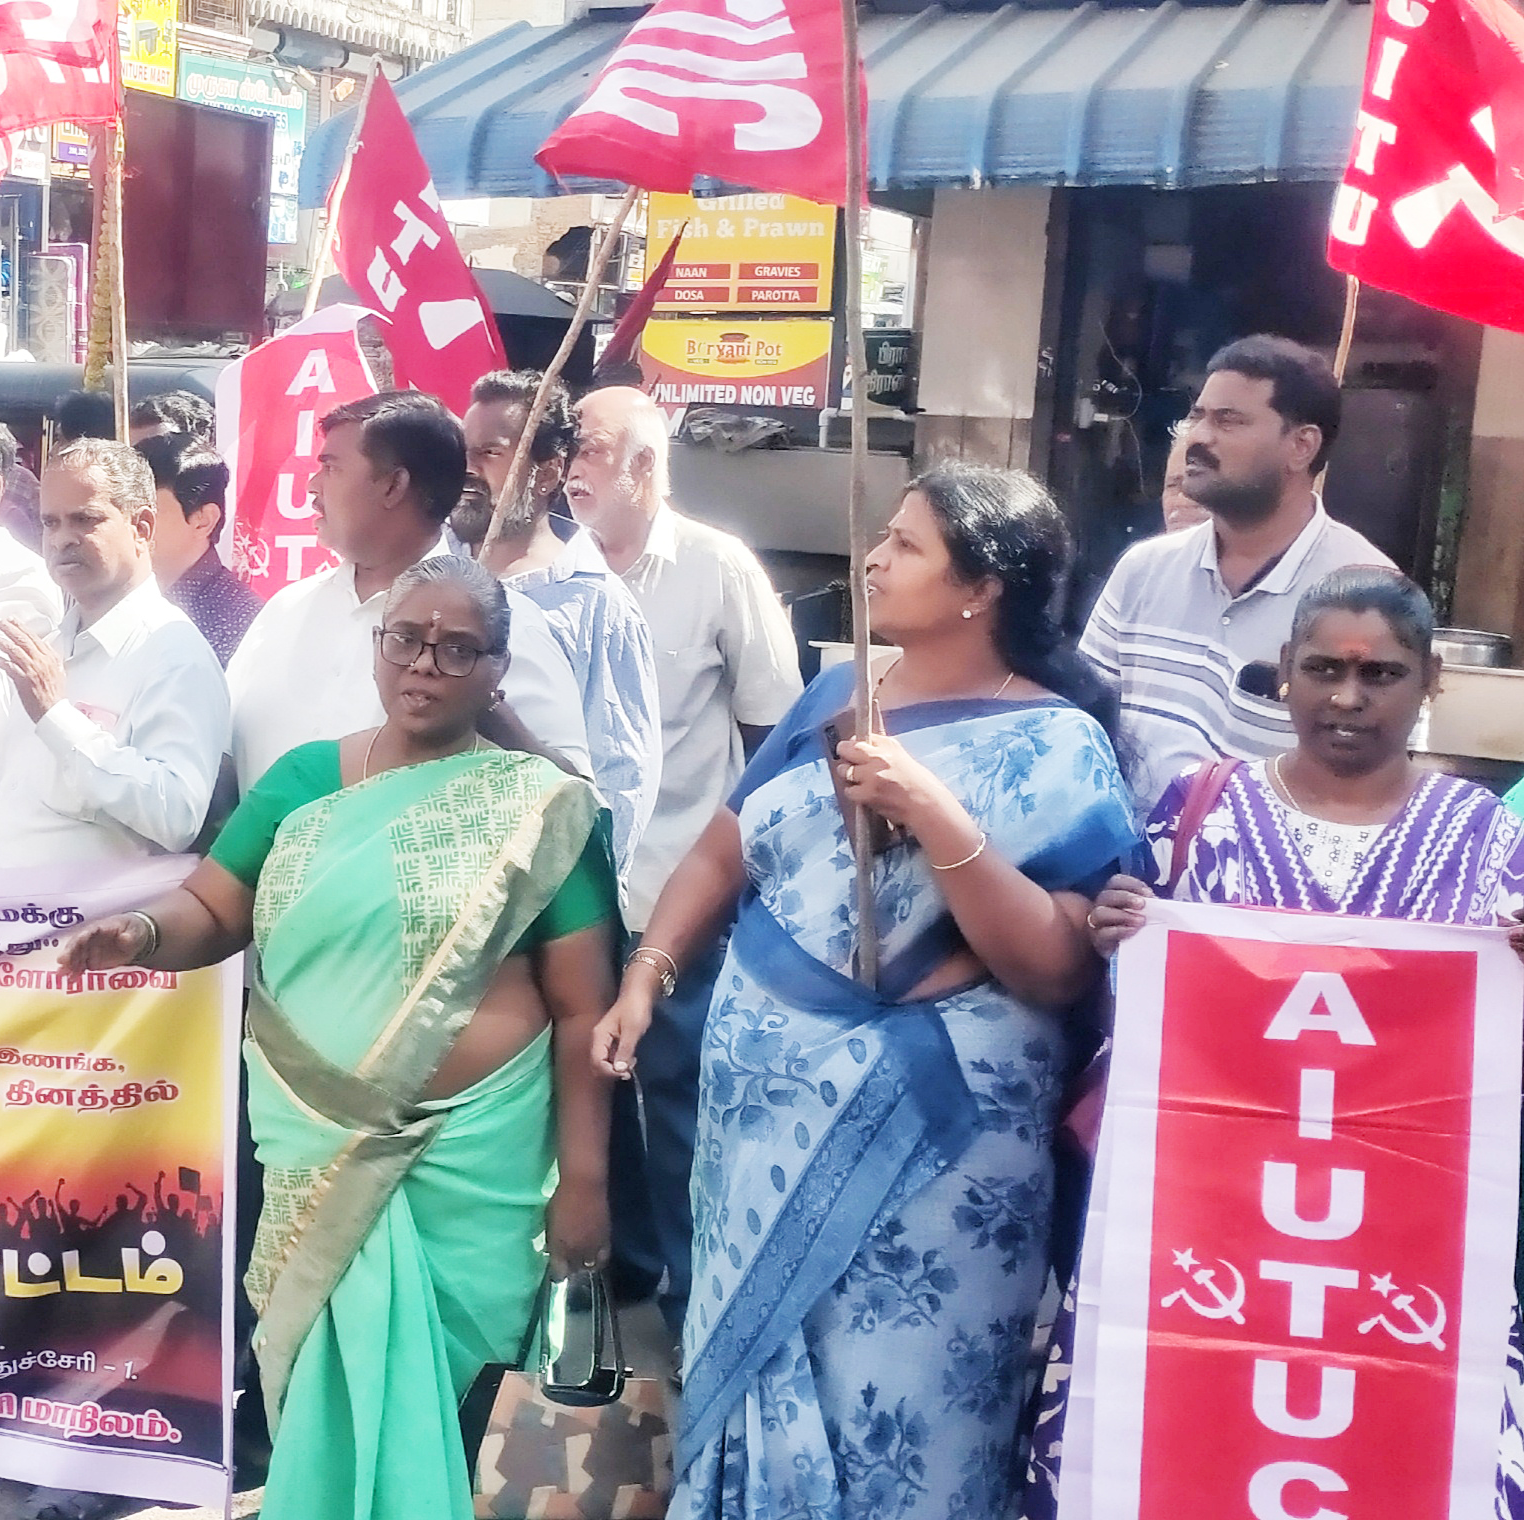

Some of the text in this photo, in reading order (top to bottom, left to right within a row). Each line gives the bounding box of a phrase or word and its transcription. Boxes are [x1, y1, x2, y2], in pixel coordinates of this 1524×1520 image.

[150, 67, 171, 86] MART
[716, 218, 736, 238] &
[743, 217, 825, 238] Prawn
[676, 267, 708, 278] NAAN
[754, 266, 801, 278] GRAVIES
[674, 289, 705, 301] DOSA
[751, 290, 801, 301] PAROTTA
[755, 340, 782, 357] Pot
[649, 384, 816, 406] UNLIMITED NON VEG
[5, 1078, 180, 1114] தினத்தில்
[1247, 971, 1377, 1520] AIUTUC
[21, 1395, 182, 1443] மாநிலம்.
